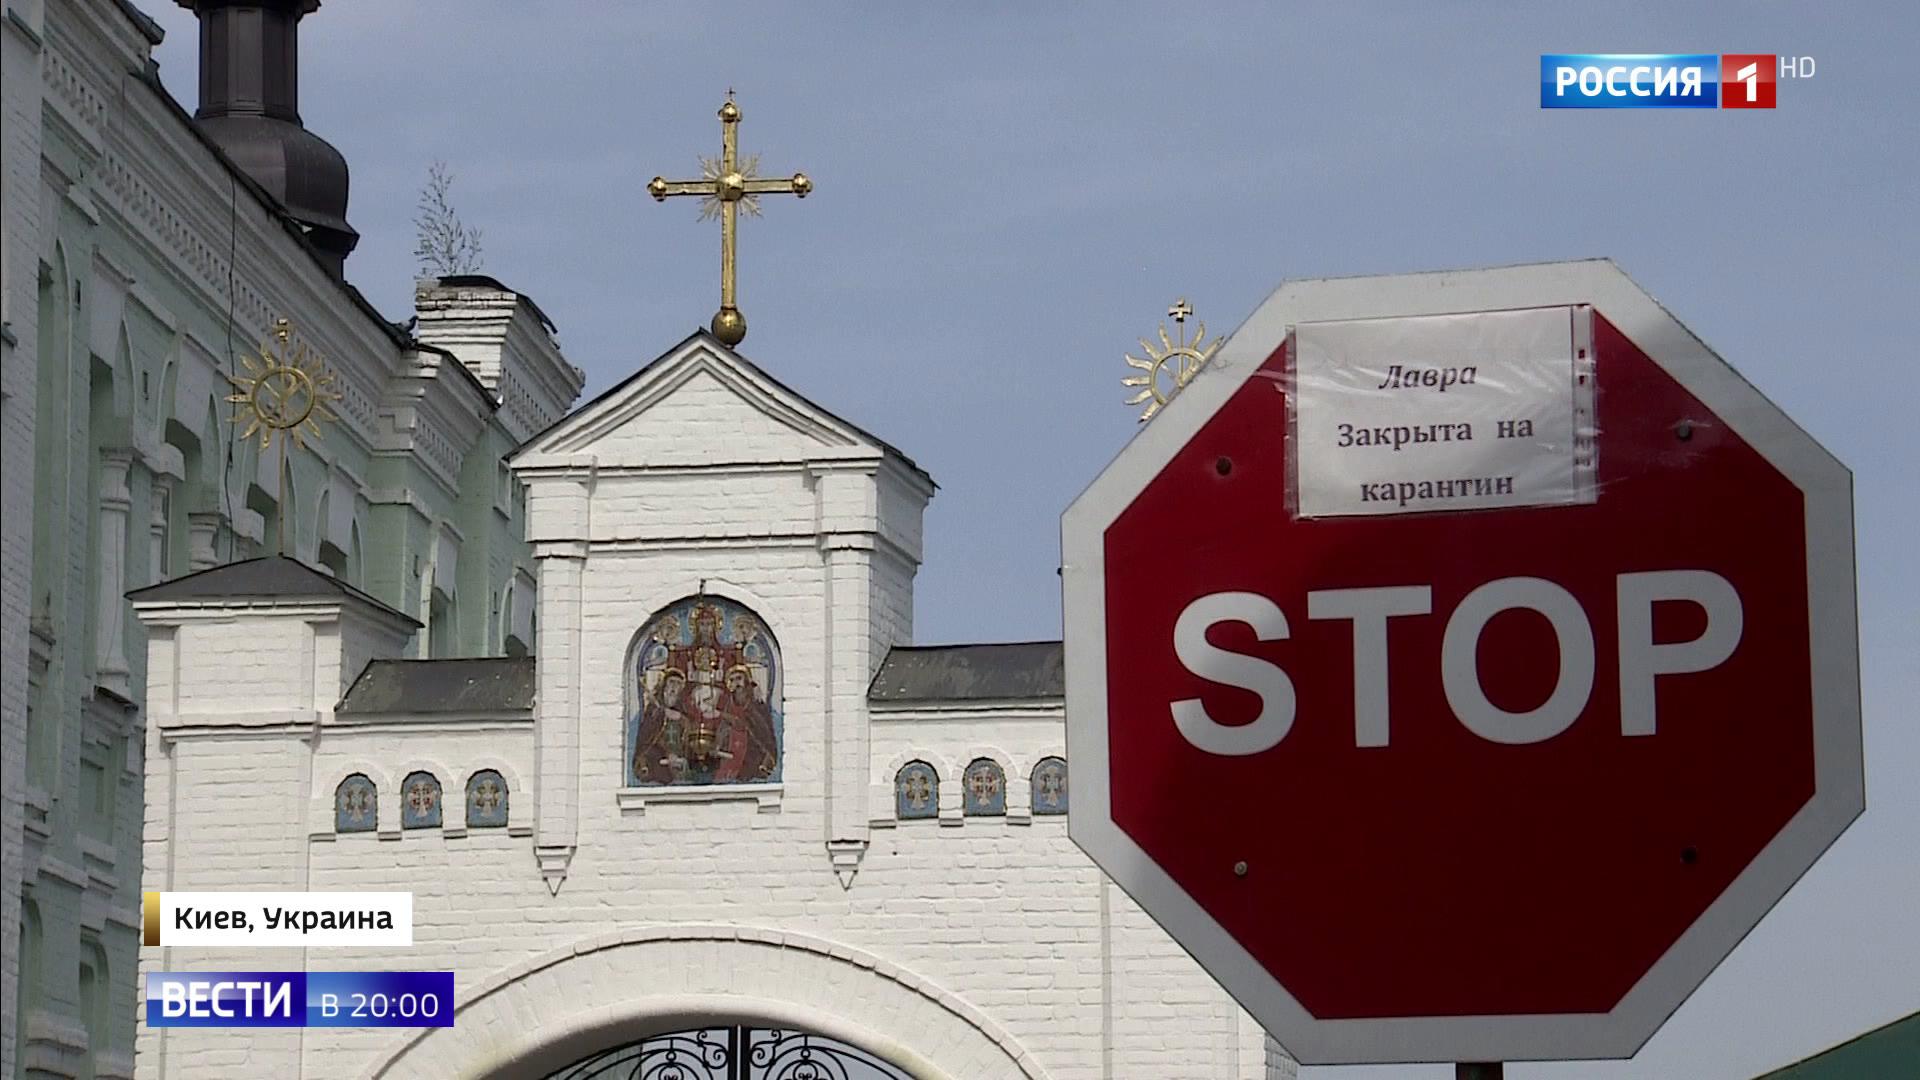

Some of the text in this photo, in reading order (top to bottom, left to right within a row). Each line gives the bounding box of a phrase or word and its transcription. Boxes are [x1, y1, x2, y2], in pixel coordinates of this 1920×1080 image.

[1378, 364, 1477, 392] Лавра
[1337, 418, 1534, 450] Закрыта на
[1361, 476, 1514, 506] карантин
[1170, 569, 1743, 756] STOP
